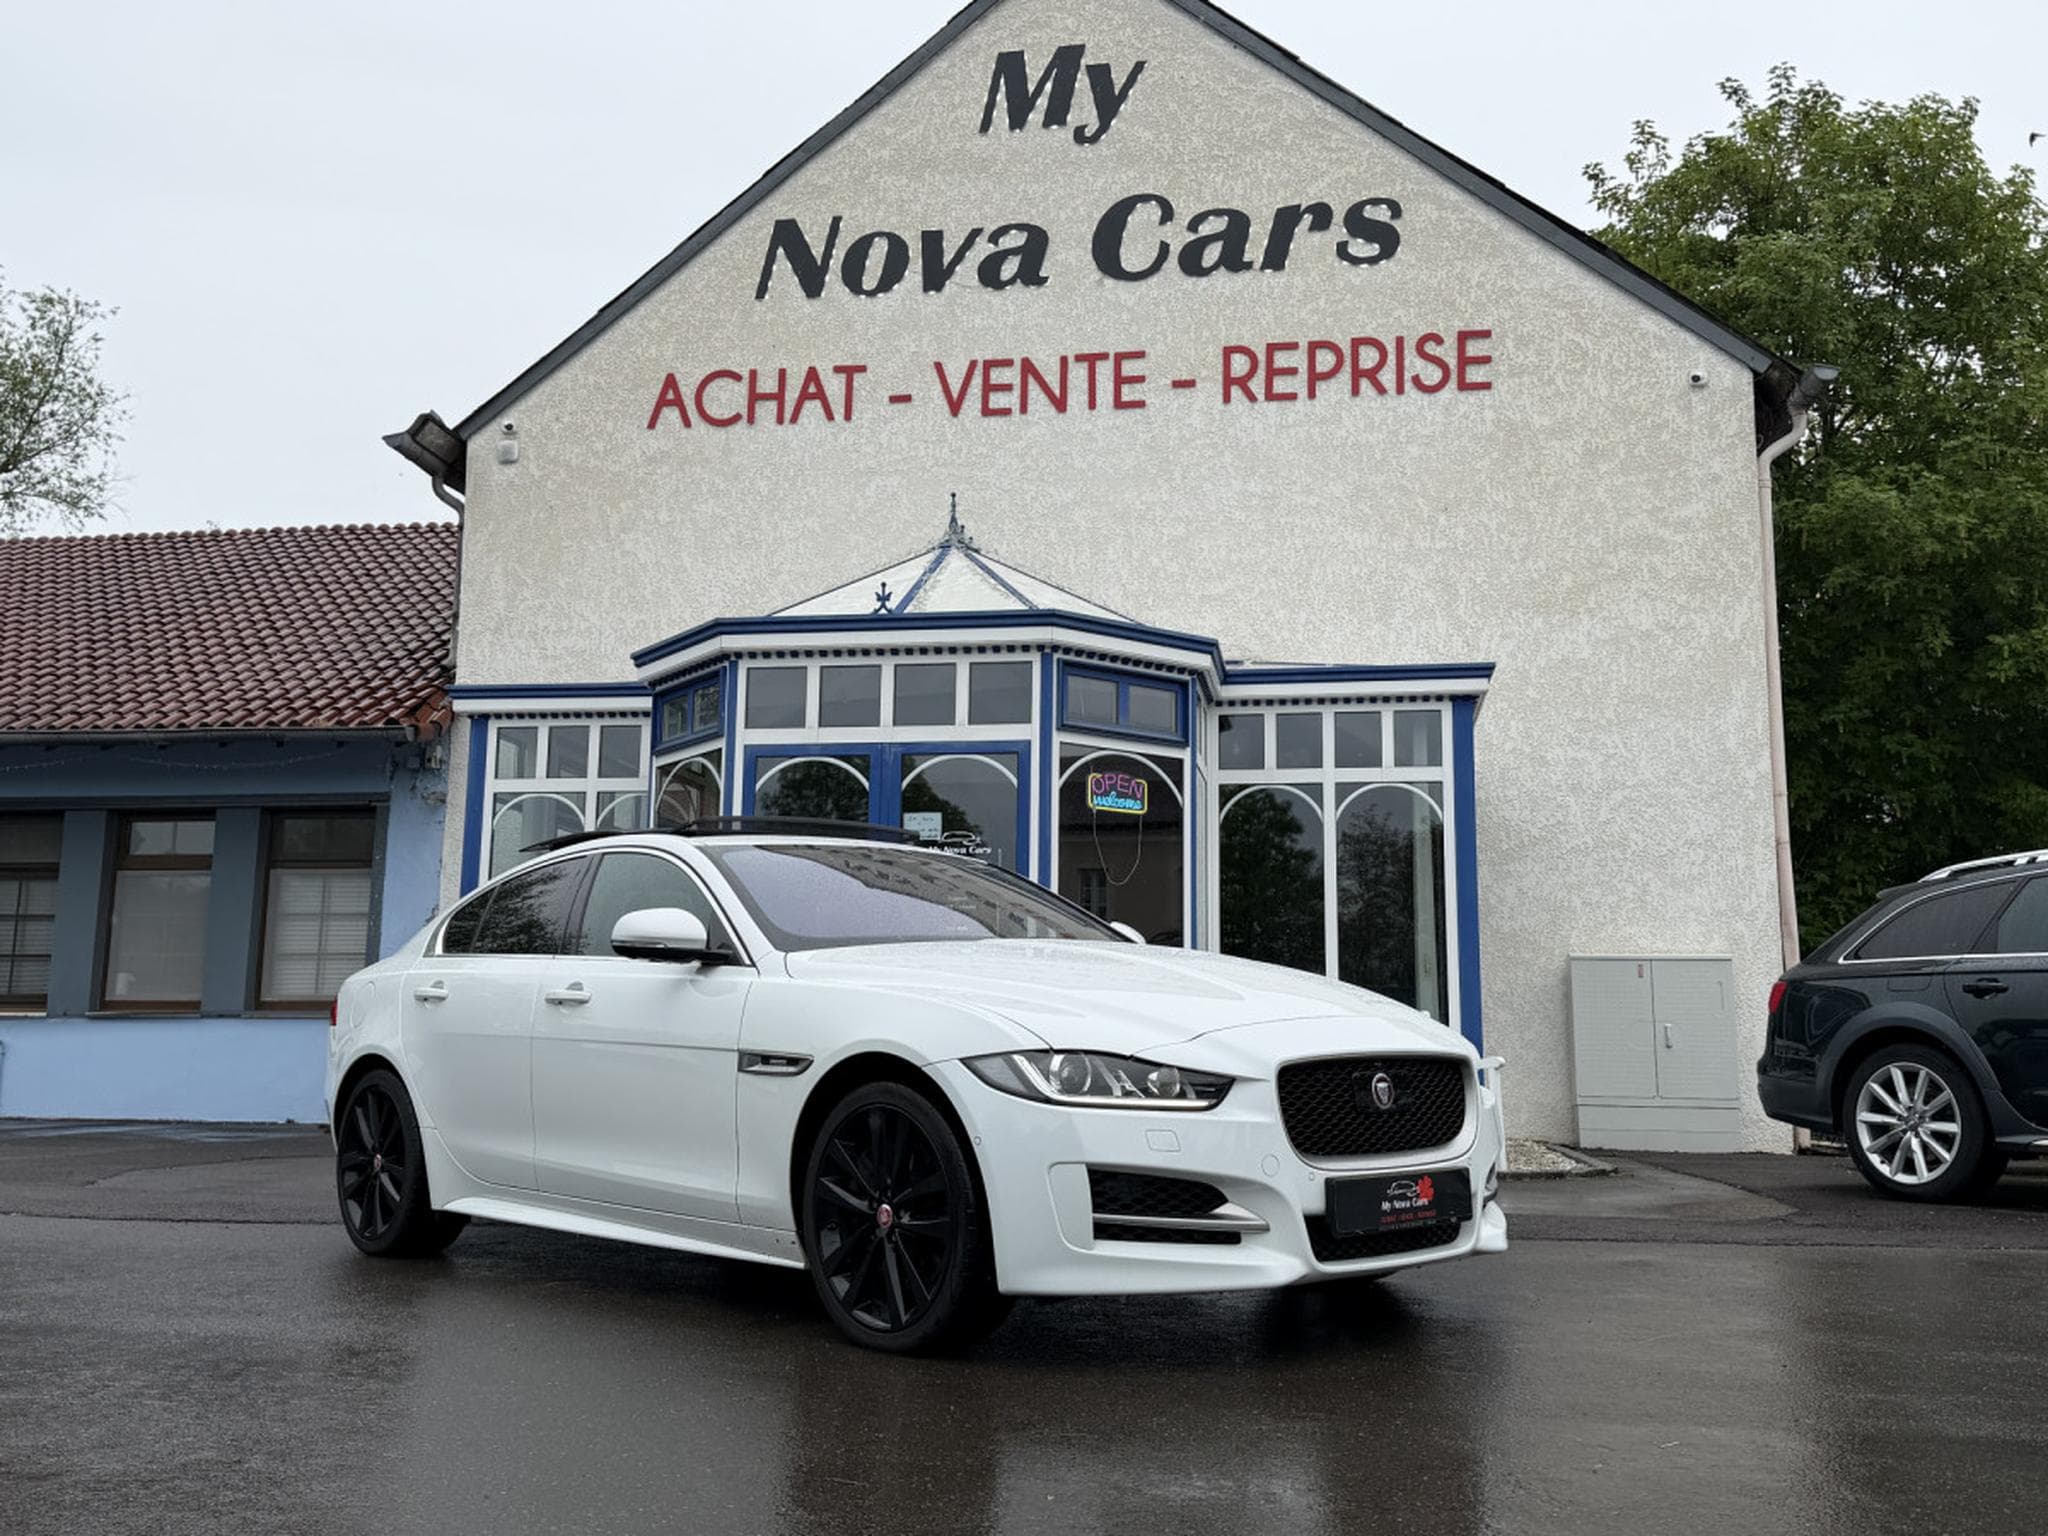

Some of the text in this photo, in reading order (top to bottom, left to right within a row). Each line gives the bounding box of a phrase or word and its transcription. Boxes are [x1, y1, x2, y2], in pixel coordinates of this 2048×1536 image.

[979, 44, 1147, 145] My
[755, 193, 1403, 301] Nova Cars
[648, 365, 866, 430] ACHAT
[934, 351, 1146, 417] VENTE
[1221, 330, 1492, 404] REPRISE
[1092, 774, 1143, 800] OPEN
[1381, 1200, 1391, 1213] My
